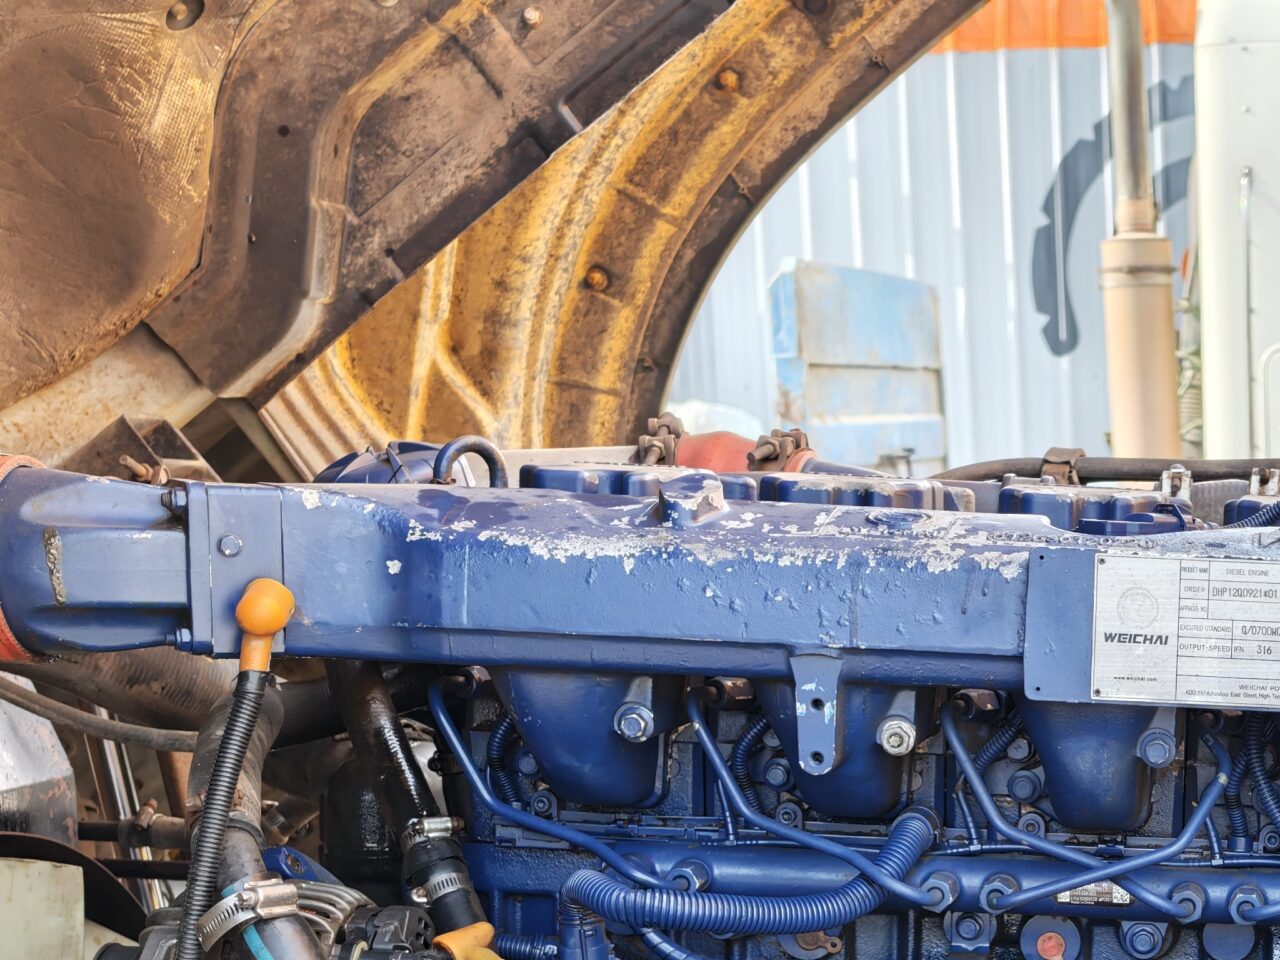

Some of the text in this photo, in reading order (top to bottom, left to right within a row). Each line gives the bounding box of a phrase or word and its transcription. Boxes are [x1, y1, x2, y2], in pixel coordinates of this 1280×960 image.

[1248, 569, 1270, 577] ENGINE
[1184, 585, 1206, 594] ORDER
[1104, 632, 1169, 646] WEICHAI
[1256, 645, 1272, 655] 316
[1239, 684, 1268, 692] WEICHAI
